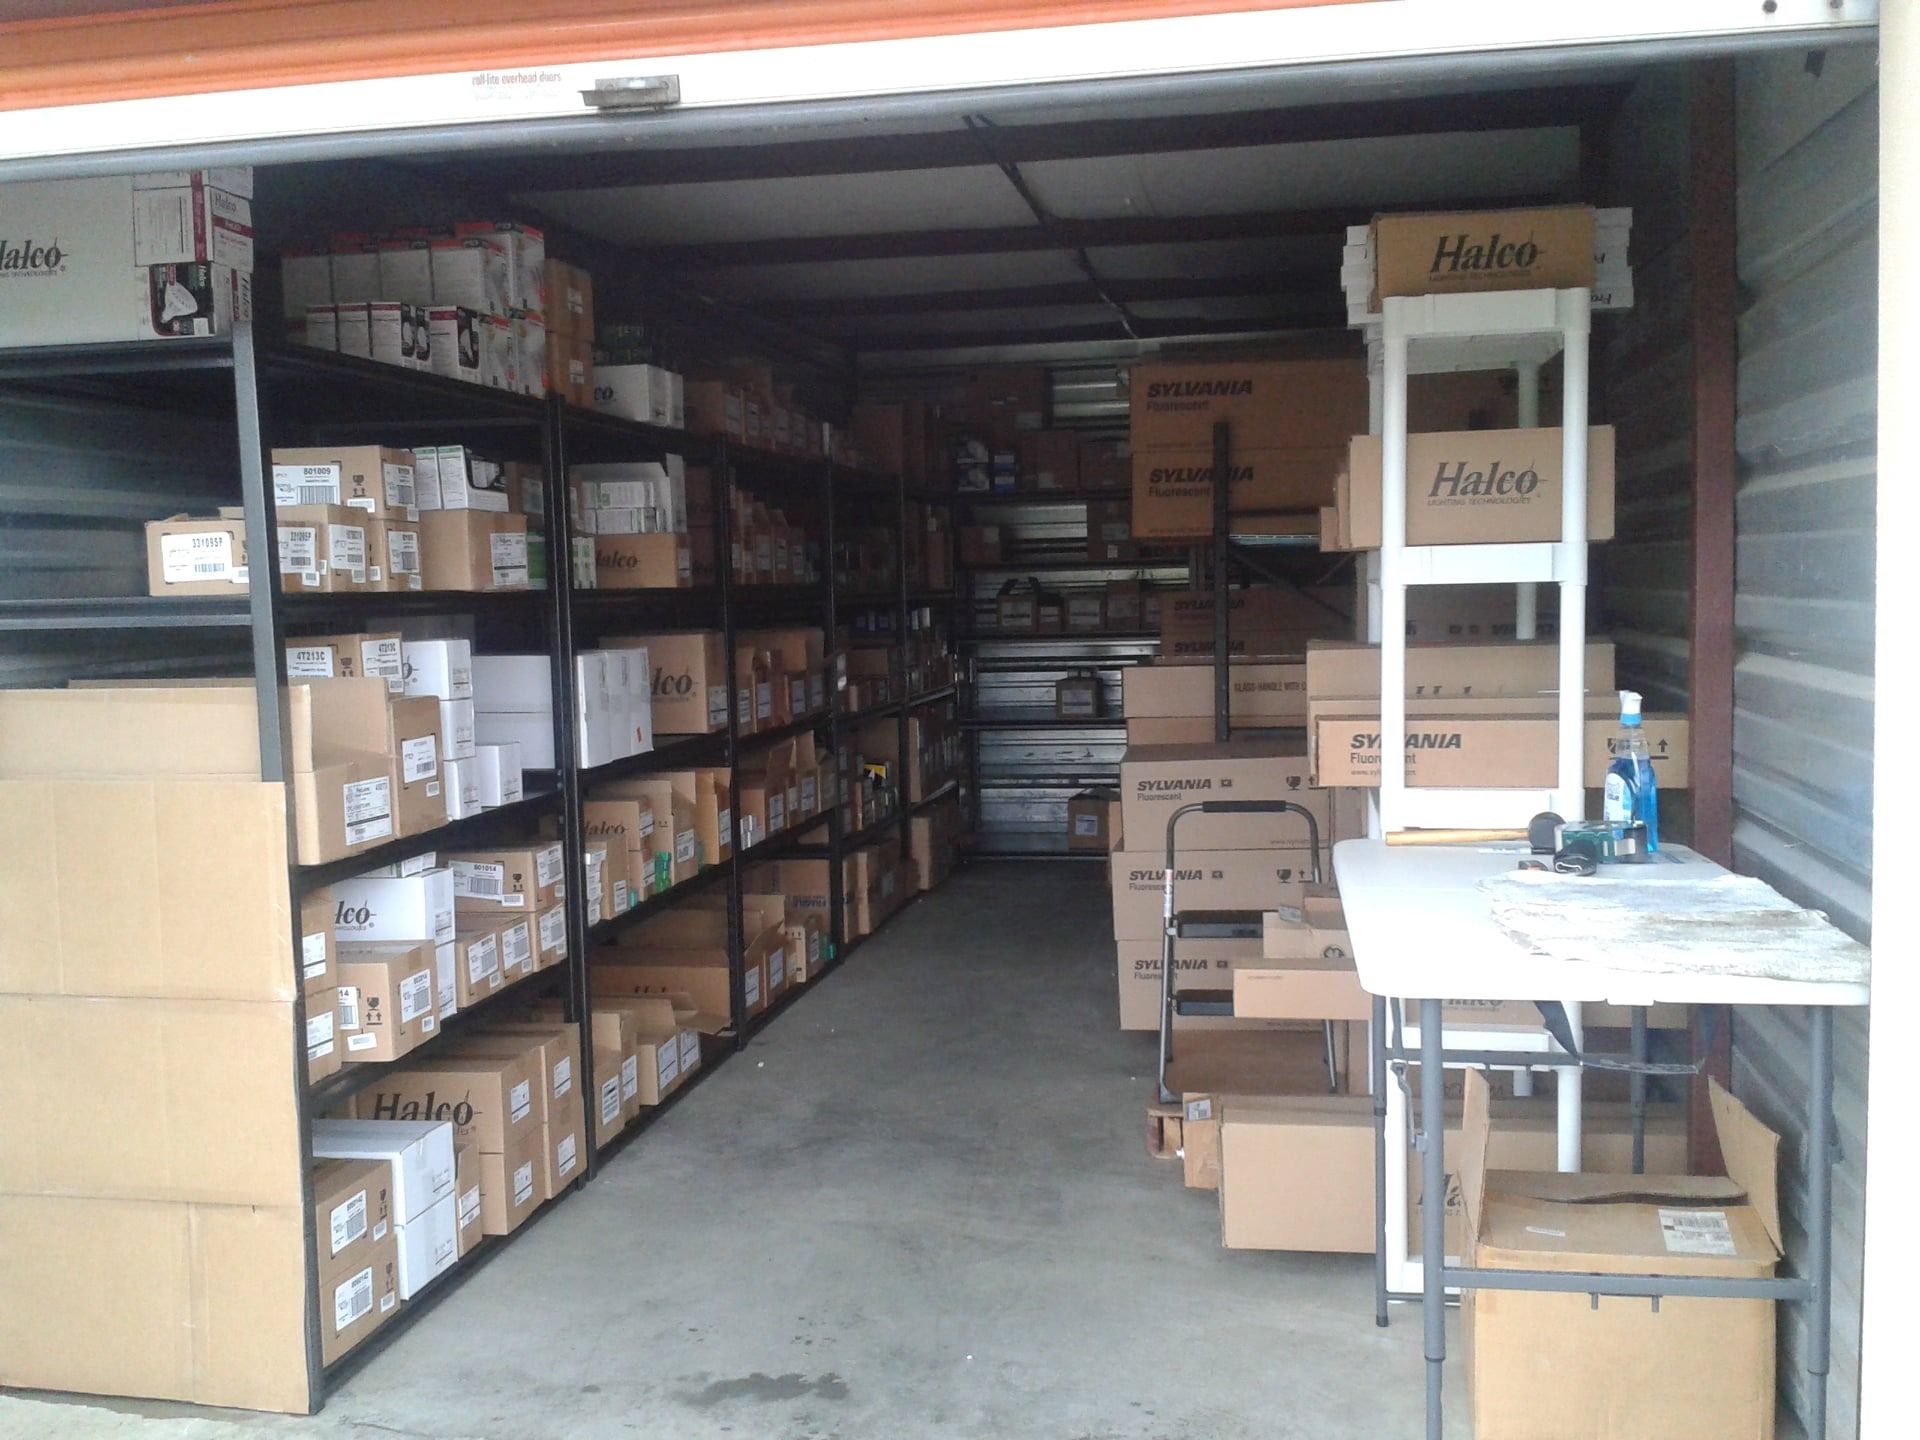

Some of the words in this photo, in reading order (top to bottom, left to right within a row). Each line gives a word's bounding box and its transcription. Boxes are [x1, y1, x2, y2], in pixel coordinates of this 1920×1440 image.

[502, 72, 537, 84] overhead
[1429, 232, 1540, 273] Halco
[1148, 380, 1253, 397] SYLVANIA
[1150, 466, 1254, 483] SYLVAIA
[1428, 460, 1541, 497] Halco
[296, 651, 326, 662] 4T213C
[651, 666, 697, 696] lco
[1351, 733, 1462, 749] SYANIA
[1137, 779, 1212, 791] SYLVANIA
[1137, 793, 1182, 801] Fluorescent
[1129, 869, 1203, 881] SYLVNIA
[335, 900, 373, 927] lco
[1134, 959, 1208, 971] SYLANIA
[374, 1090, 482, 1126] Halco
